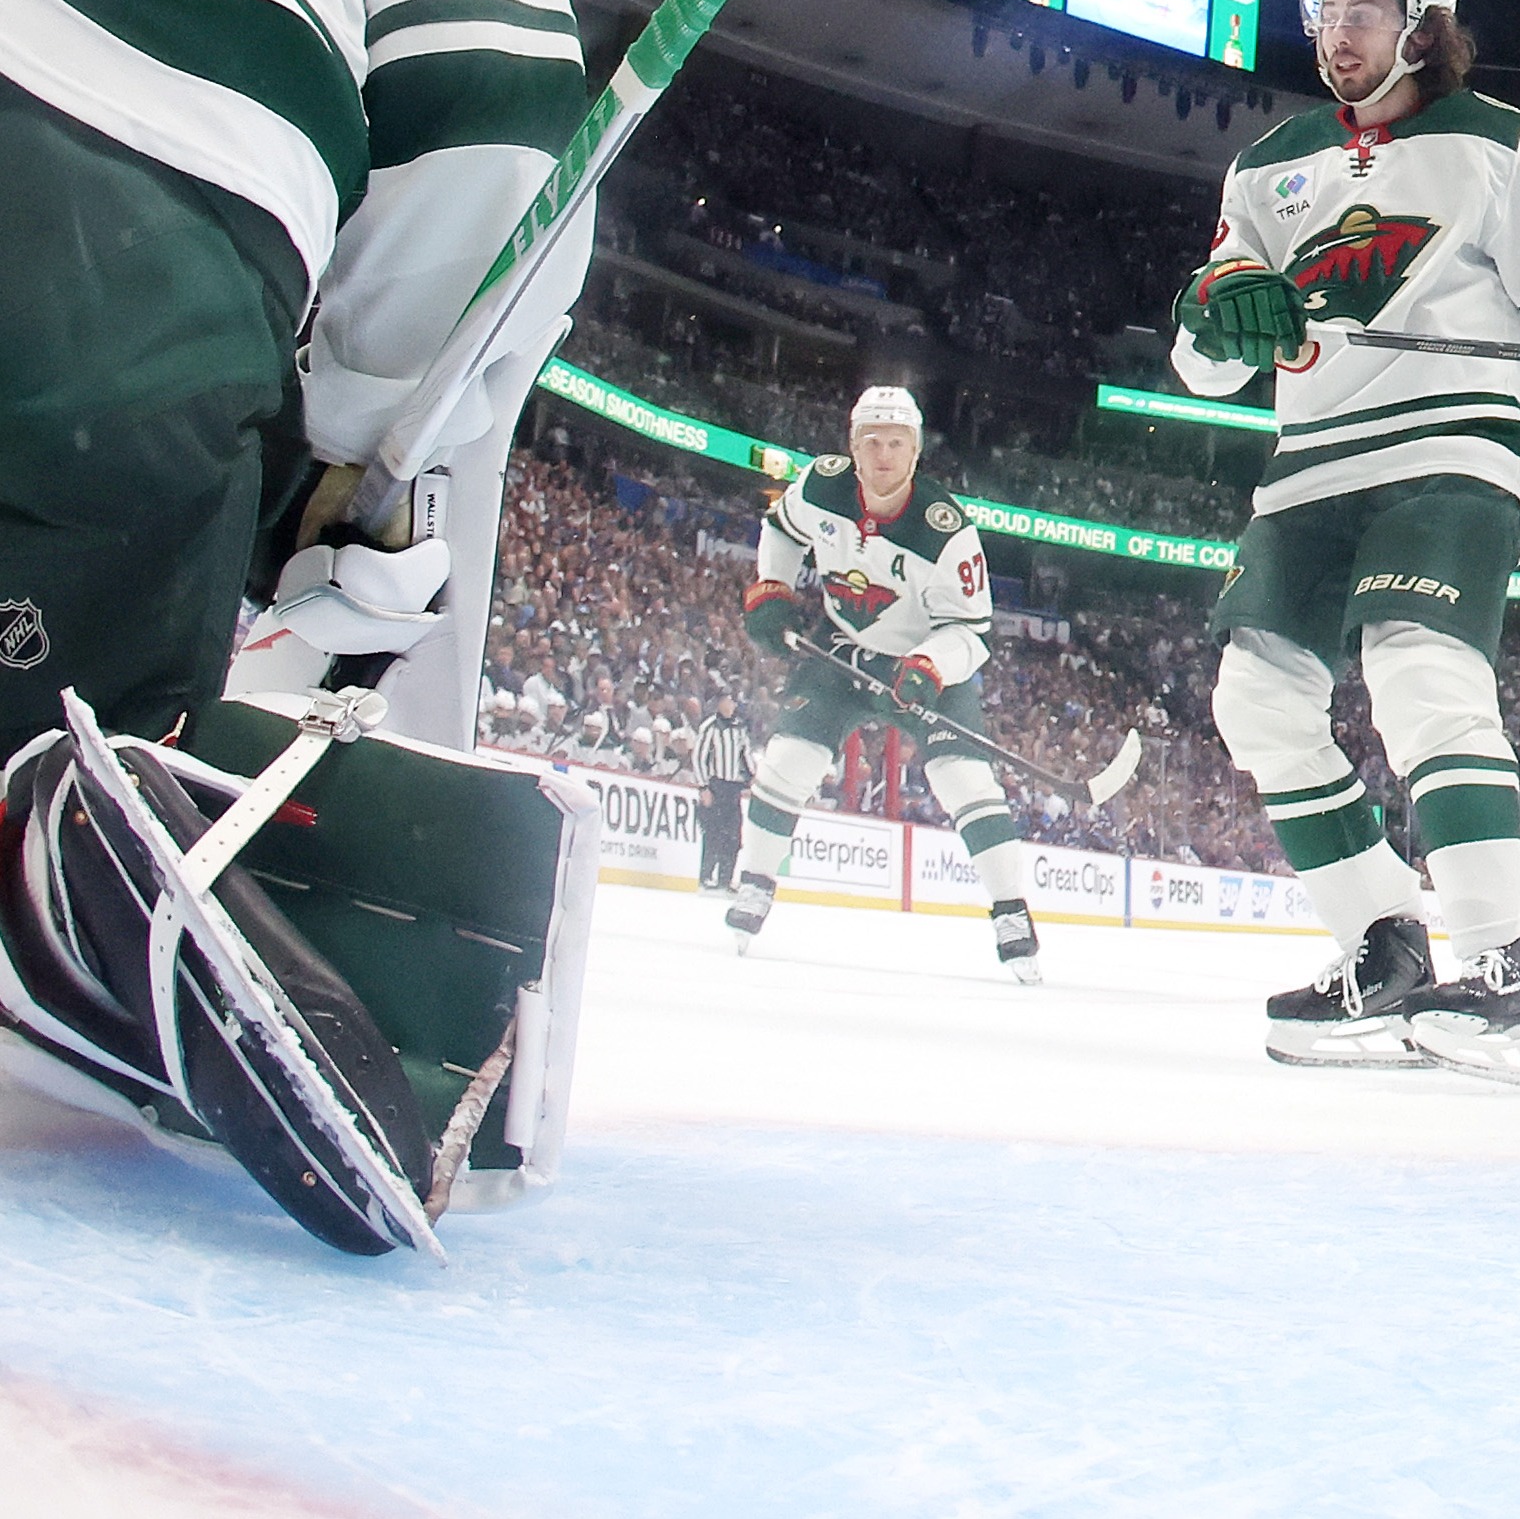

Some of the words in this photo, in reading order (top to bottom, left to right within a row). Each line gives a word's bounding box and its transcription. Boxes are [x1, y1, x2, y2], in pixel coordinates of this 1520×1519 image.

[1276, 197, 1313, 222] TRIA
[605, 391, 709, 452] SMOOTHNESS
[964, 503, 1031, 535] PROUD
[1033, 516, 1118, 552] PARTNER
[1127, 535, 1156, 558] OF
[1156, 540, 1196, 564] THE
[890, 553, 907, 583] A
[957, 551, 985, 599] 97
[1353, 573, 1461, 605] BAUER
[3, 615, 35, 656] NHL
[789, 832, 889, 872] nterprise
[1033, 854, 1080, 893] Great
[1082, 860, 1116, 906] Clips
[1168, 878, 1204, 907] PEPSI
